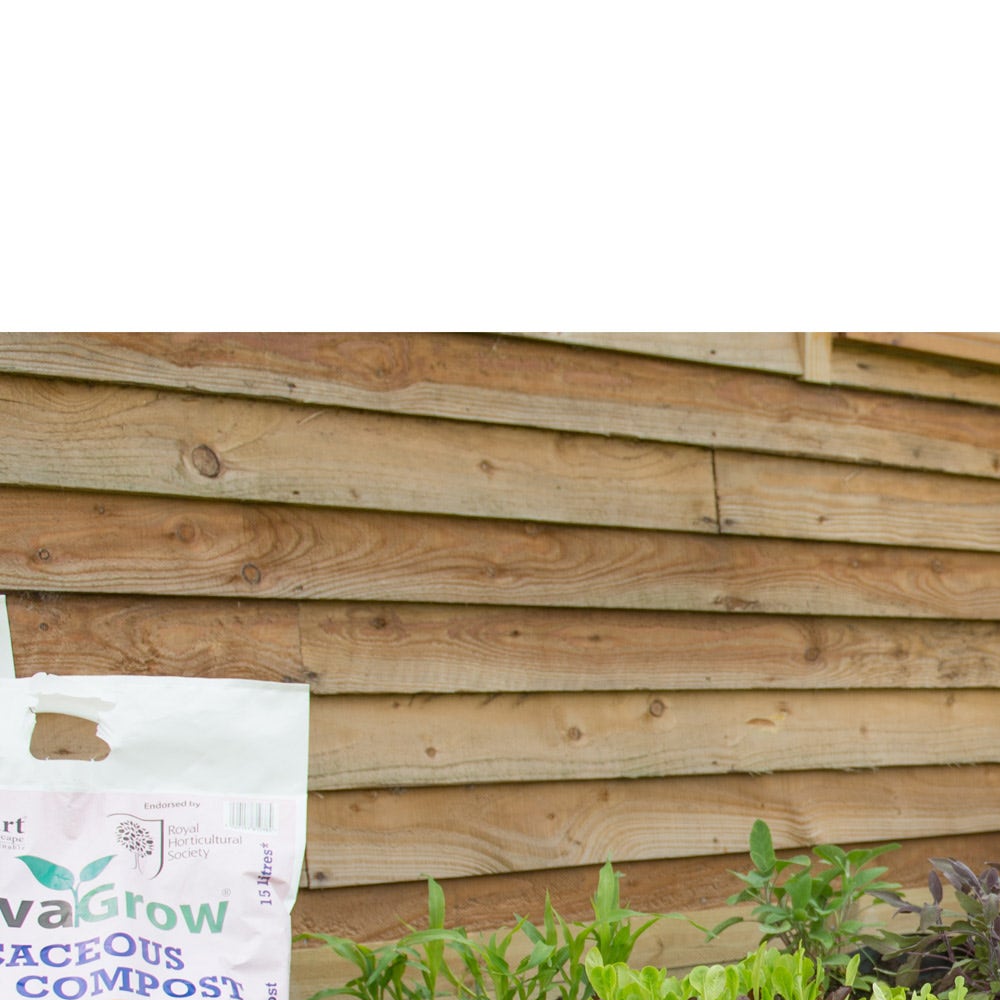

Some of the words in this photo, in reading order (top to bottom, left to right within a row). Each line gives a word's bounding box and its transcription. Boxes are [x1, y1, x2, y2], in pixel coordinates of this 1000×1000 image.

[144, 801, 187, 810] Endorsed
[189, 800, 201, 808] by
[168, 824, 199, 837] Royal
[168, 835, 242, 849] Horticultural
[168, 847, 211, 861] Society
[259, 890, 273, 905] 15
[0, 932, 185, 970] ACEOUS
[16, 967, 244, 1000] COMPOST
